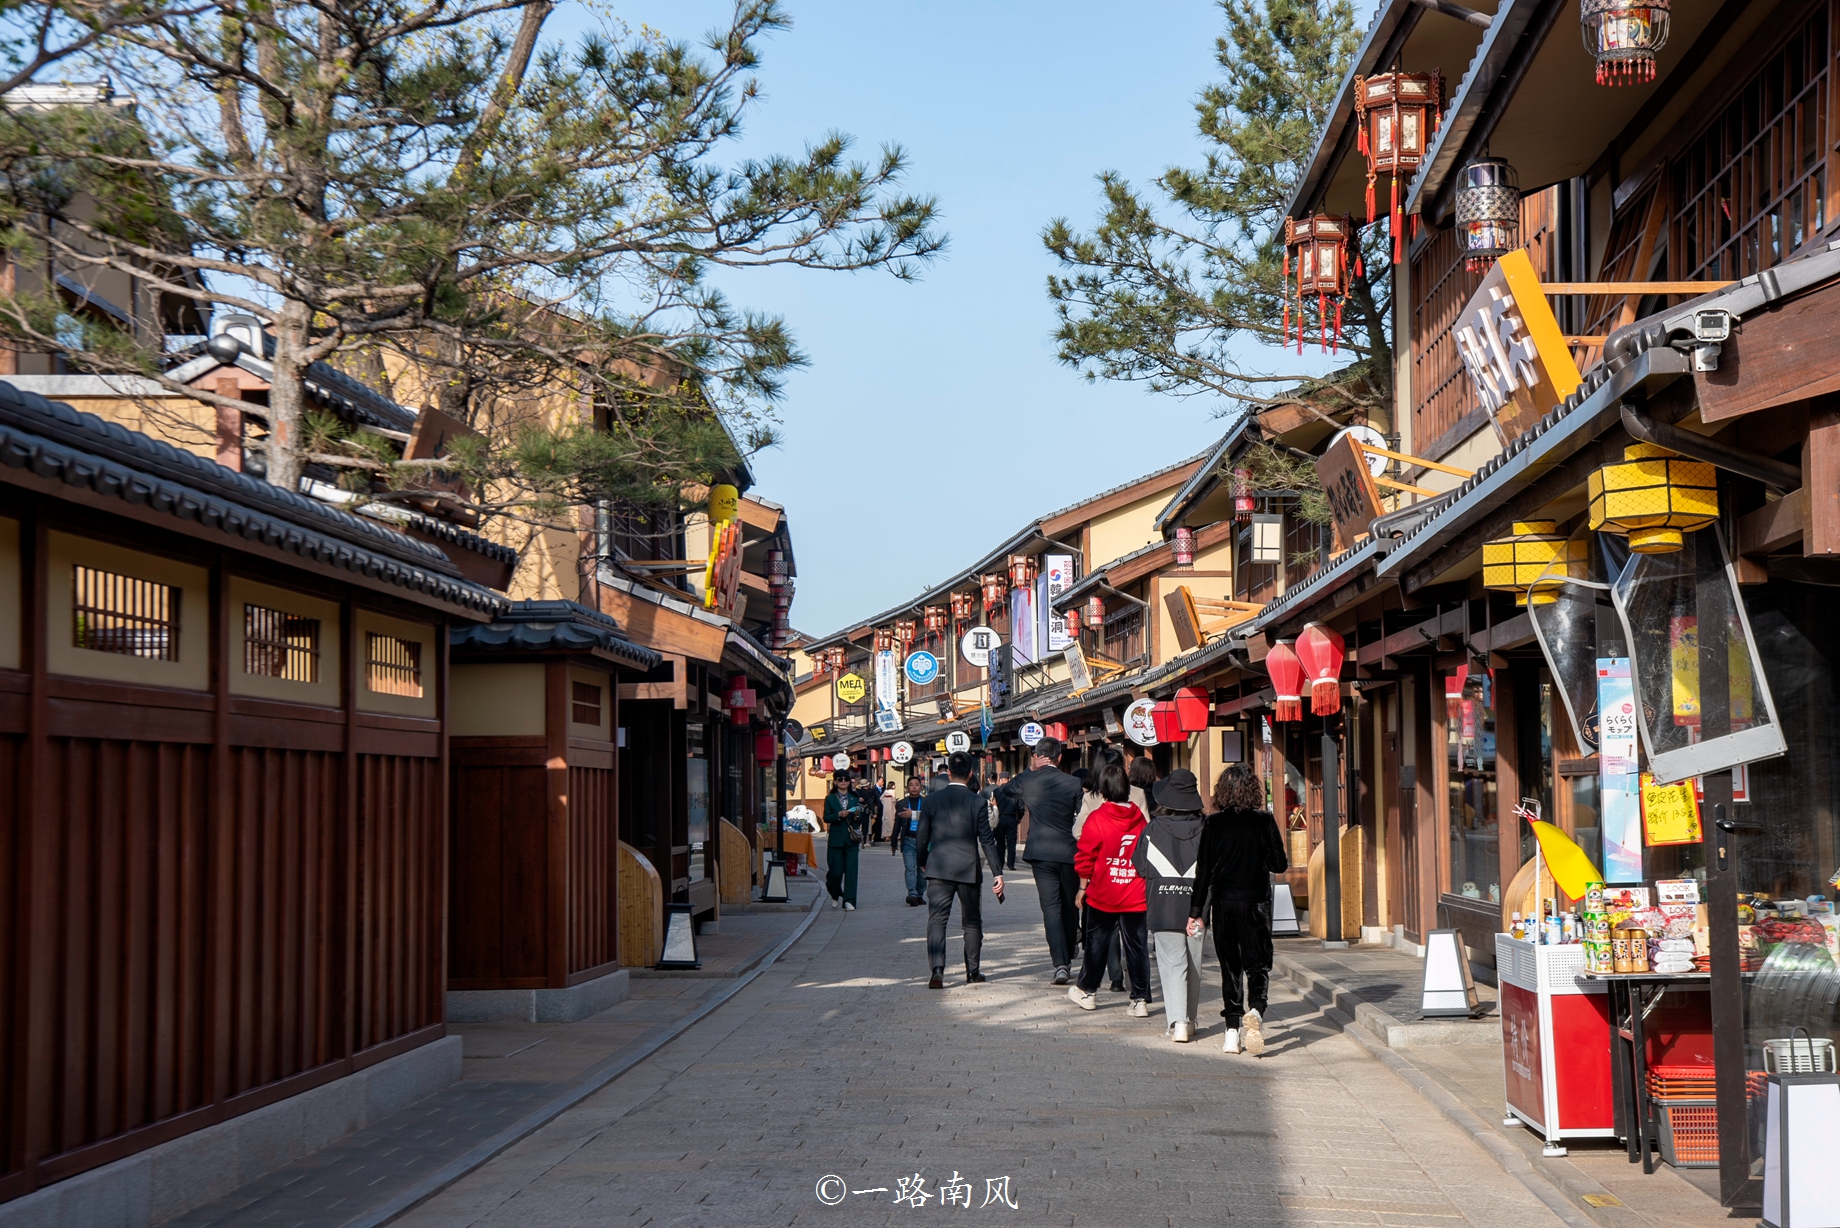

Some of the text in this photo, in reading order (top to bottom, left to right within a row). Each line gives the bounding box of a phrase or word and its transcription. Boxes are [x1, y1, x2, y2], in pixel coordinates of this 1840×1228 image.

[840, 680, 862, 689] МЕД
[1606, 715, 1633, 725] らくらく
[1608, 725, 1632, 734] モップ
